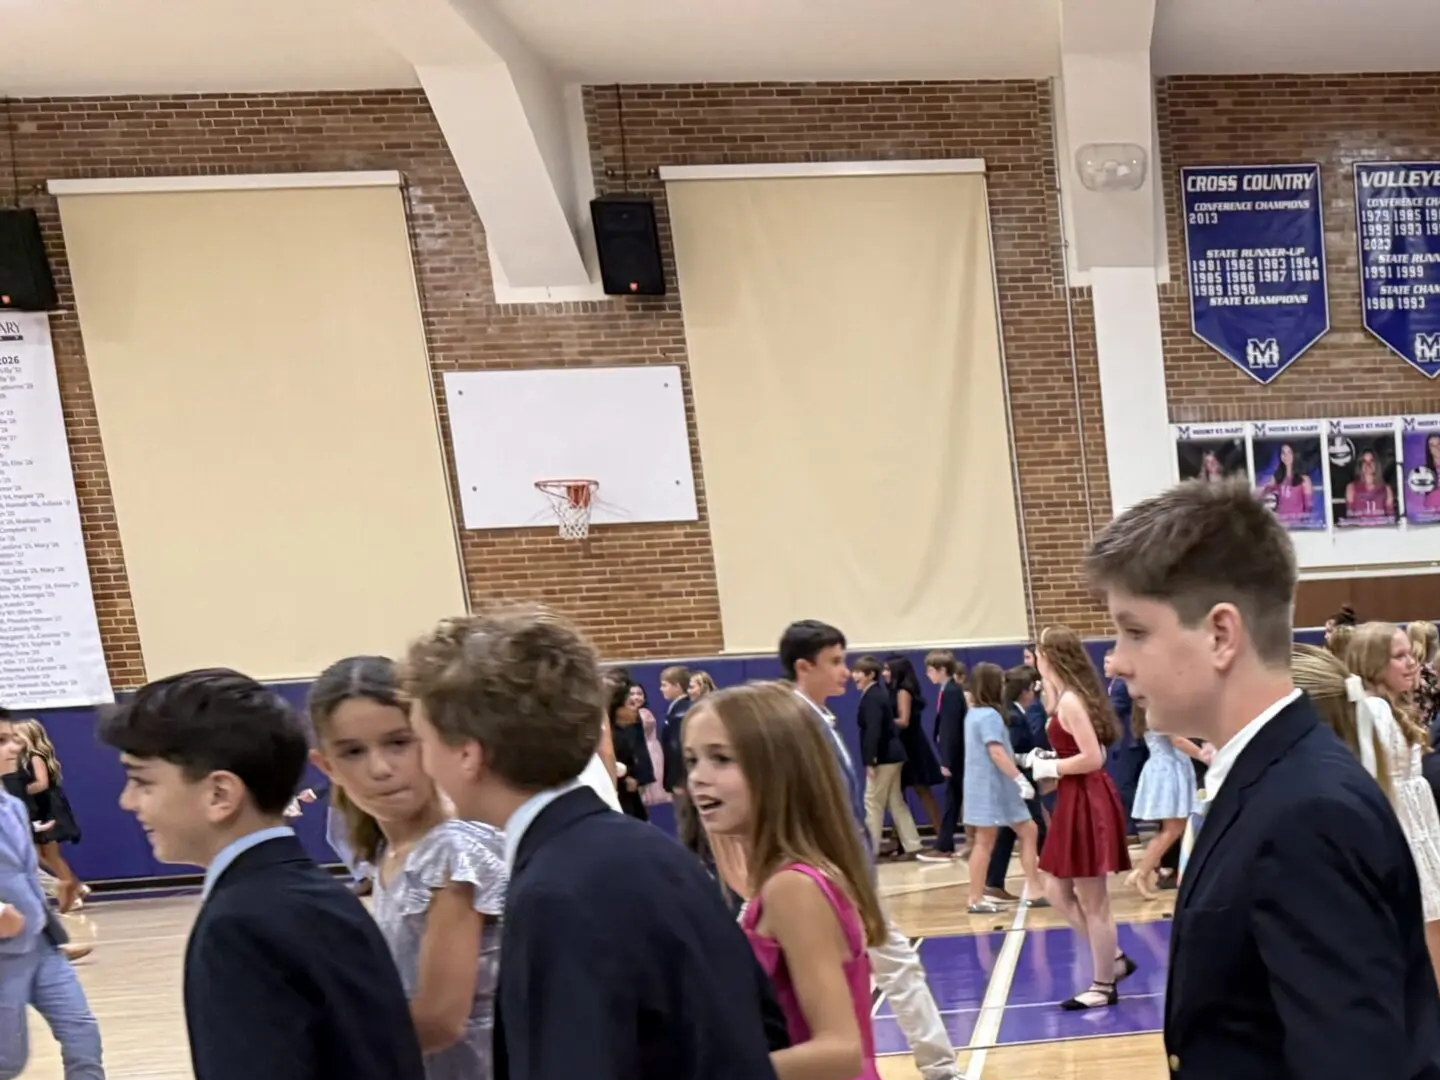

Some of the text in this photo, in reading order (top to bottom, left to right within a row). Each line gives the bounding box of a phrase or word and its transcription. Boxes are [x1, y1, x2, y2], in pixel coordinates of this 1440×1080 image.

[1187, 172, 1314, 193] CROSS COUNTRY
[1194, 200, 1310, 212] CONFERENCE CHAMPIONS
[1189, 212, 1219, 225] 2013
[1206, 247, 1306, 259] STATE RUNNER-UP
[1378, 253, 1409, 264] STATE
[1379, 285, 1410, 295] STATE
[1209, 295, 1308, 306] STATE CHAMPIONS
